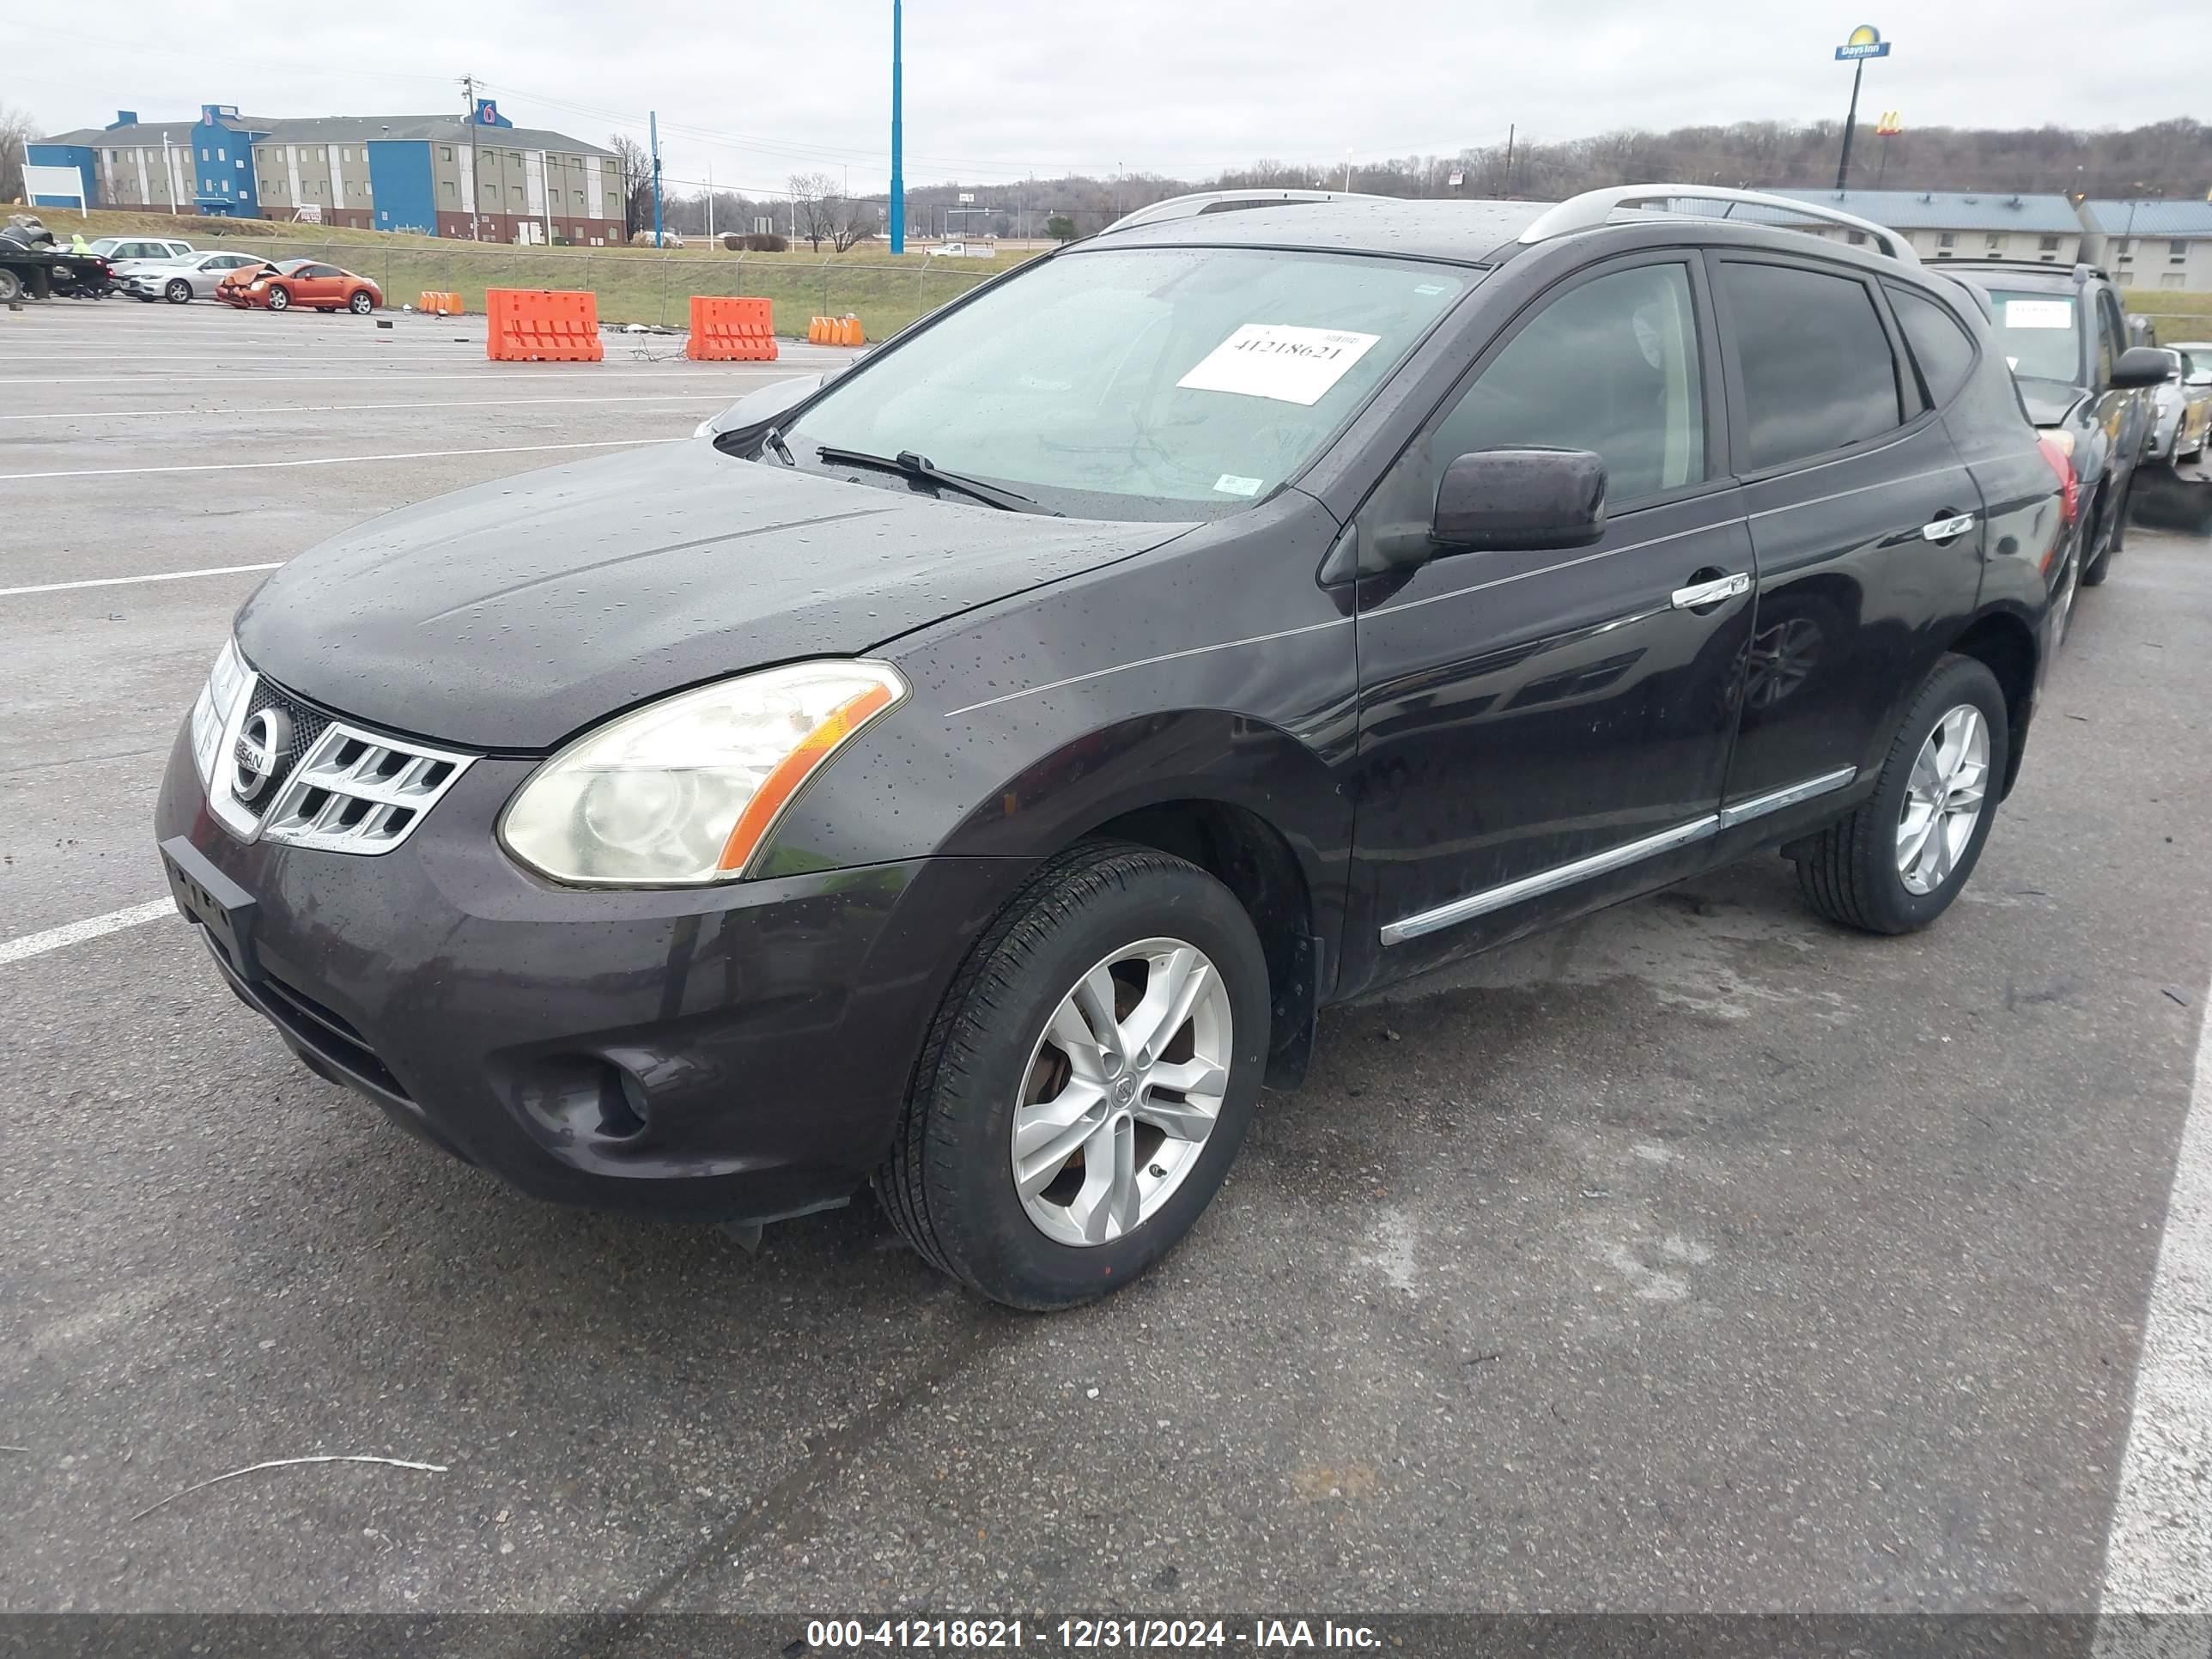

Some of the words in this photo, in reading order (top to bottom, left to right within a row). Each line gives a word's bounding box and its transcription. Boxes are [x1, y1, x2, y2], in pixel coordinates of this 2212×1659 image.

[1842, 46, 1864, 57] Days
[1864, 44, 1880, 53] Inn
[483, 103, 495, 124] 6
[1234, 339, 1343, 360] 41218621
